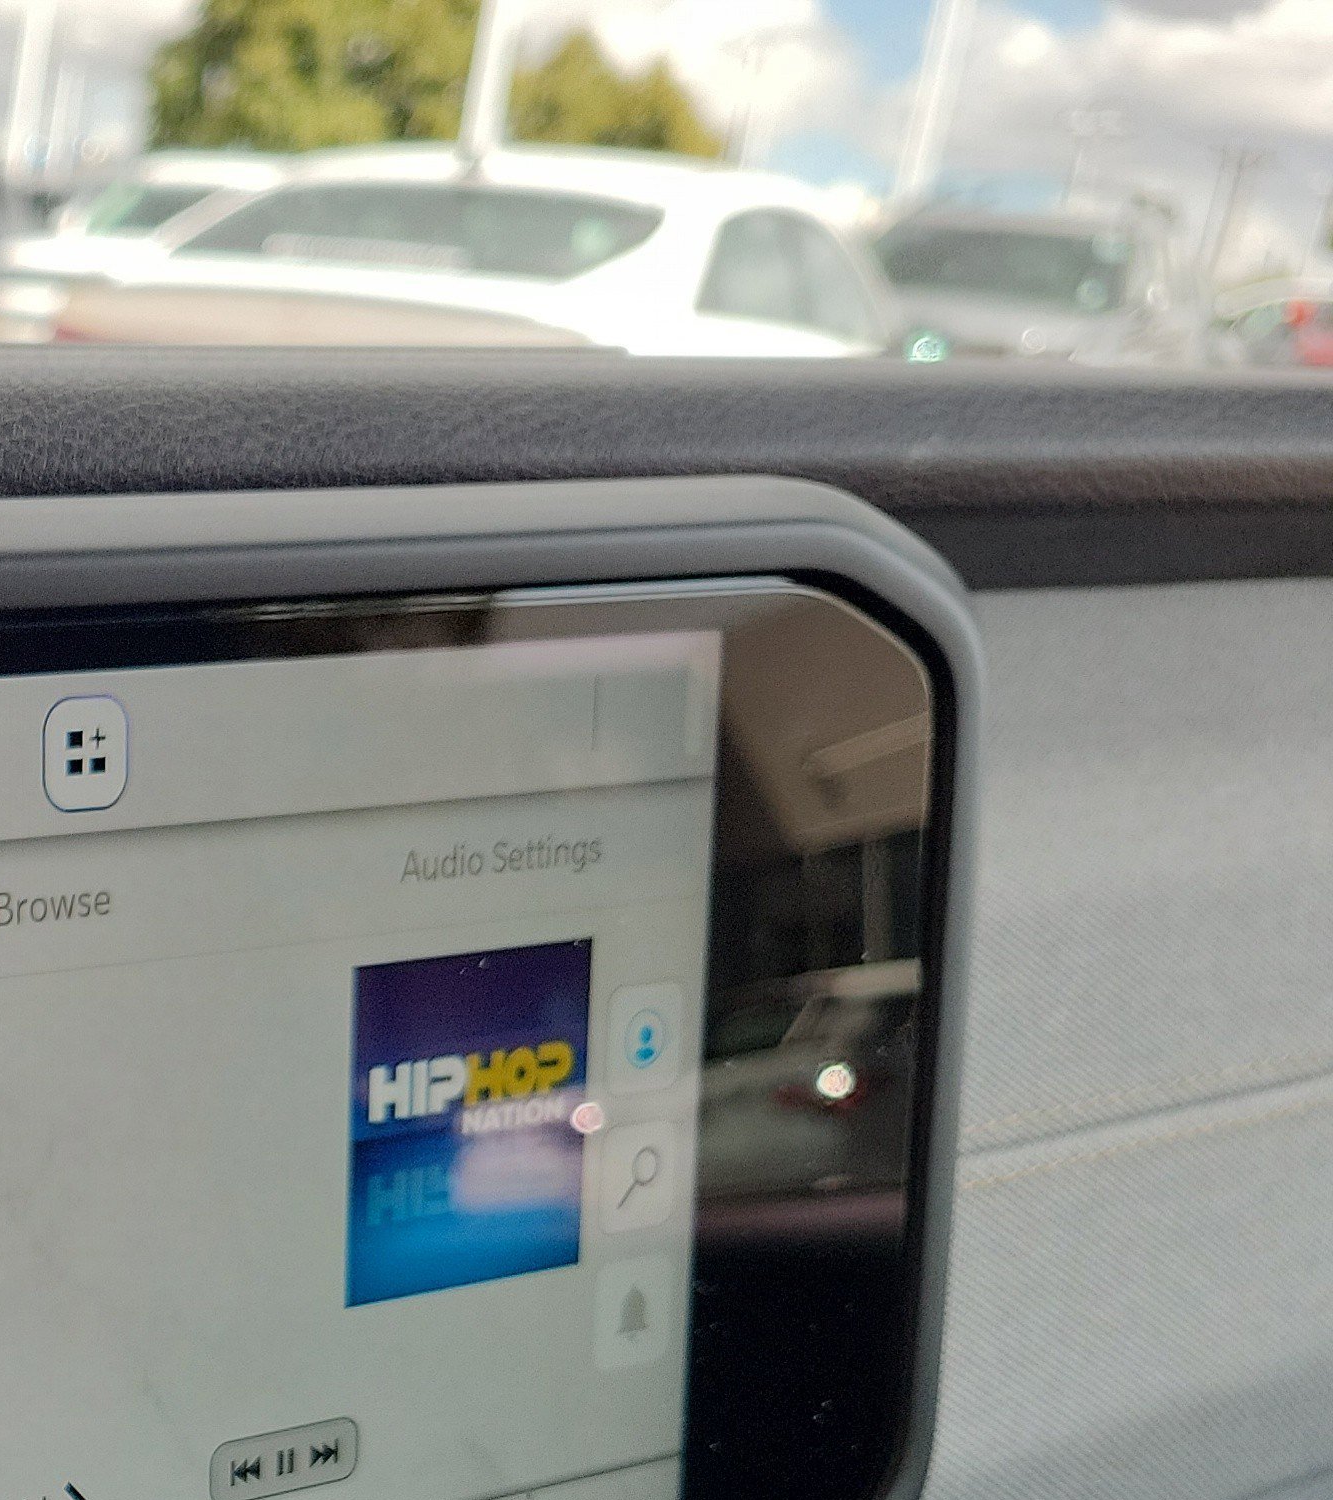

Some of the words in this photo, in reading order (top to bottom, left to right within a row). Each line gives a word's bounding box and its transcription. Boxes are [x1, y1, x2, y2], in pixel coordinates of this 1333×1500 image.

[400, 842, 485, 883] Audio
[492, 833, 603, 875] Settings
[461, 1093, 566, 1135] NATION
